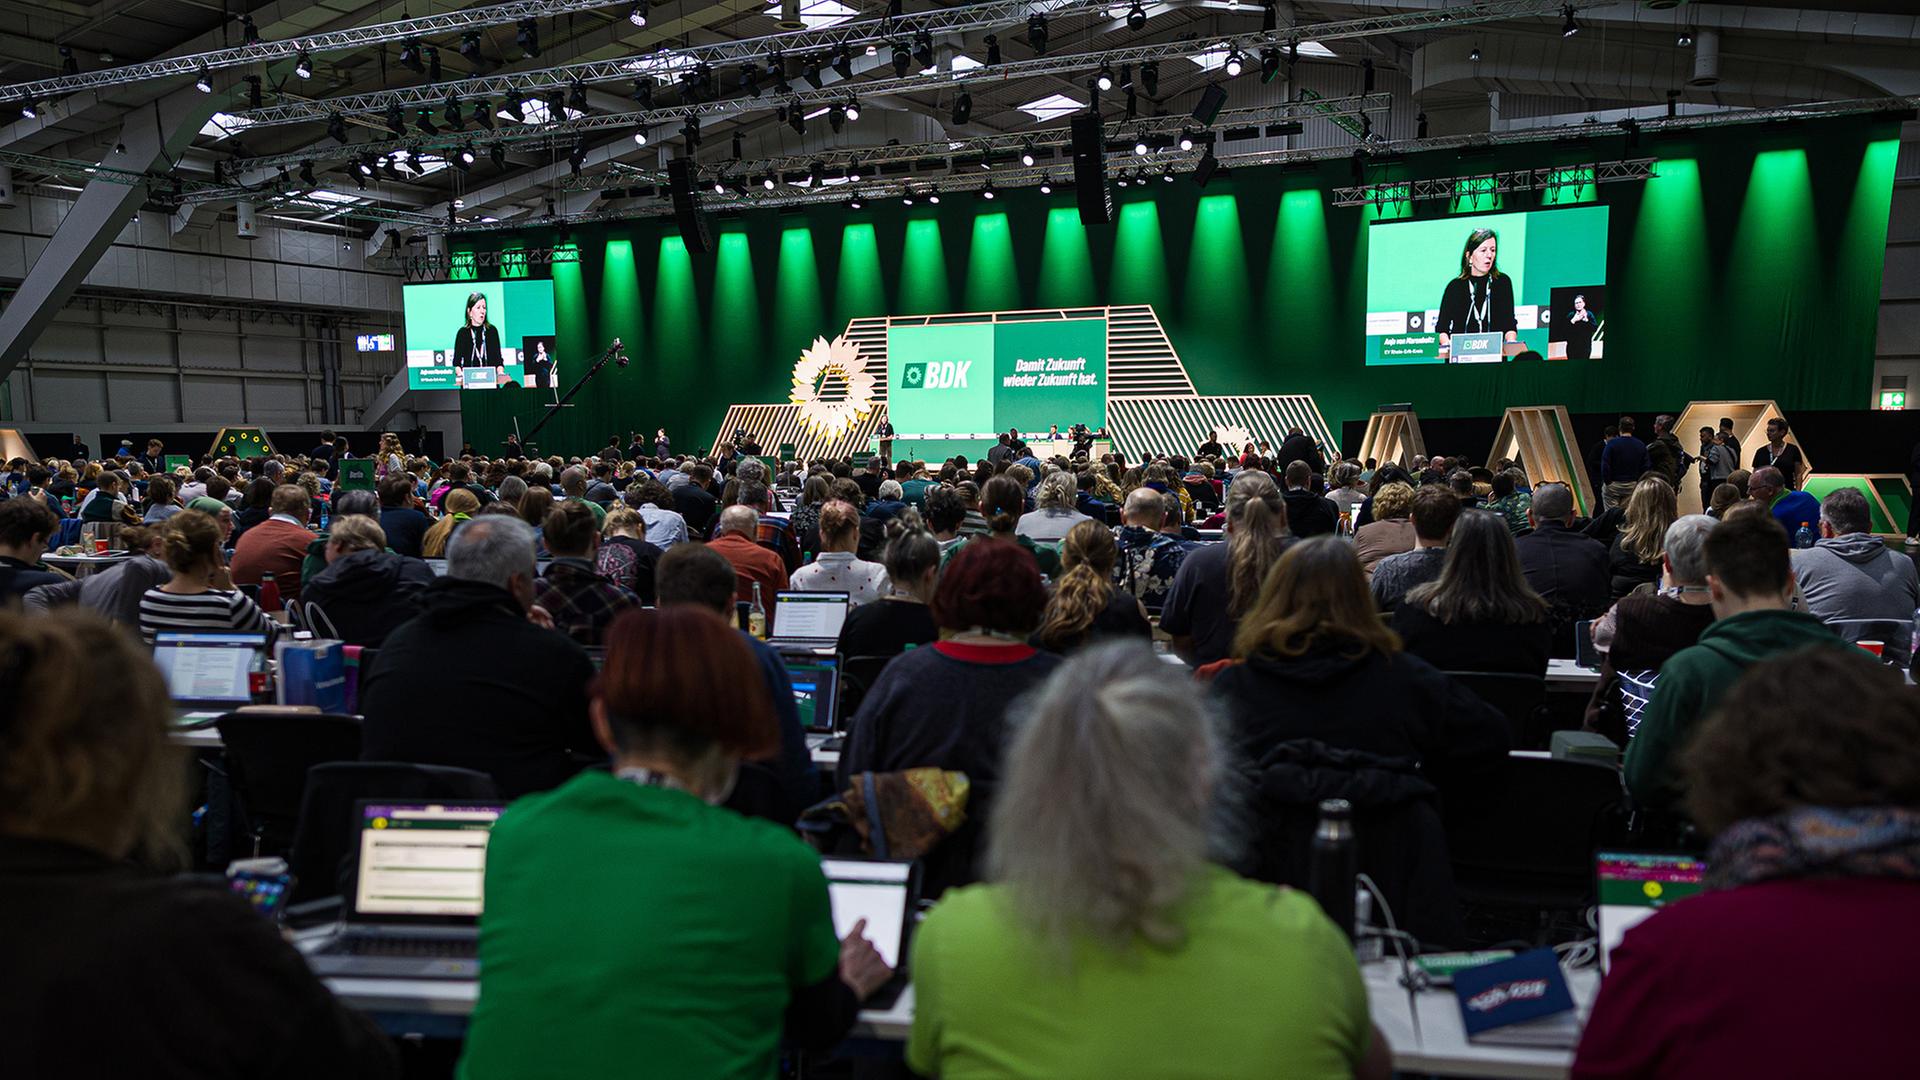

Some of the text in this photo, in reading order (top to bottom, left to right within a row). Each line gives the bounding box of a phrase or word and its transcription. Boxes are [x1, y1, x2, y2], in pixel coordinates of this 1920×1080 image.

[1015, 357, 1086, 373] Damit Zukunft
[923, 360, 972, 389] BDK
[1003, 373, 1098, 388] wieder Zukunft hat.
